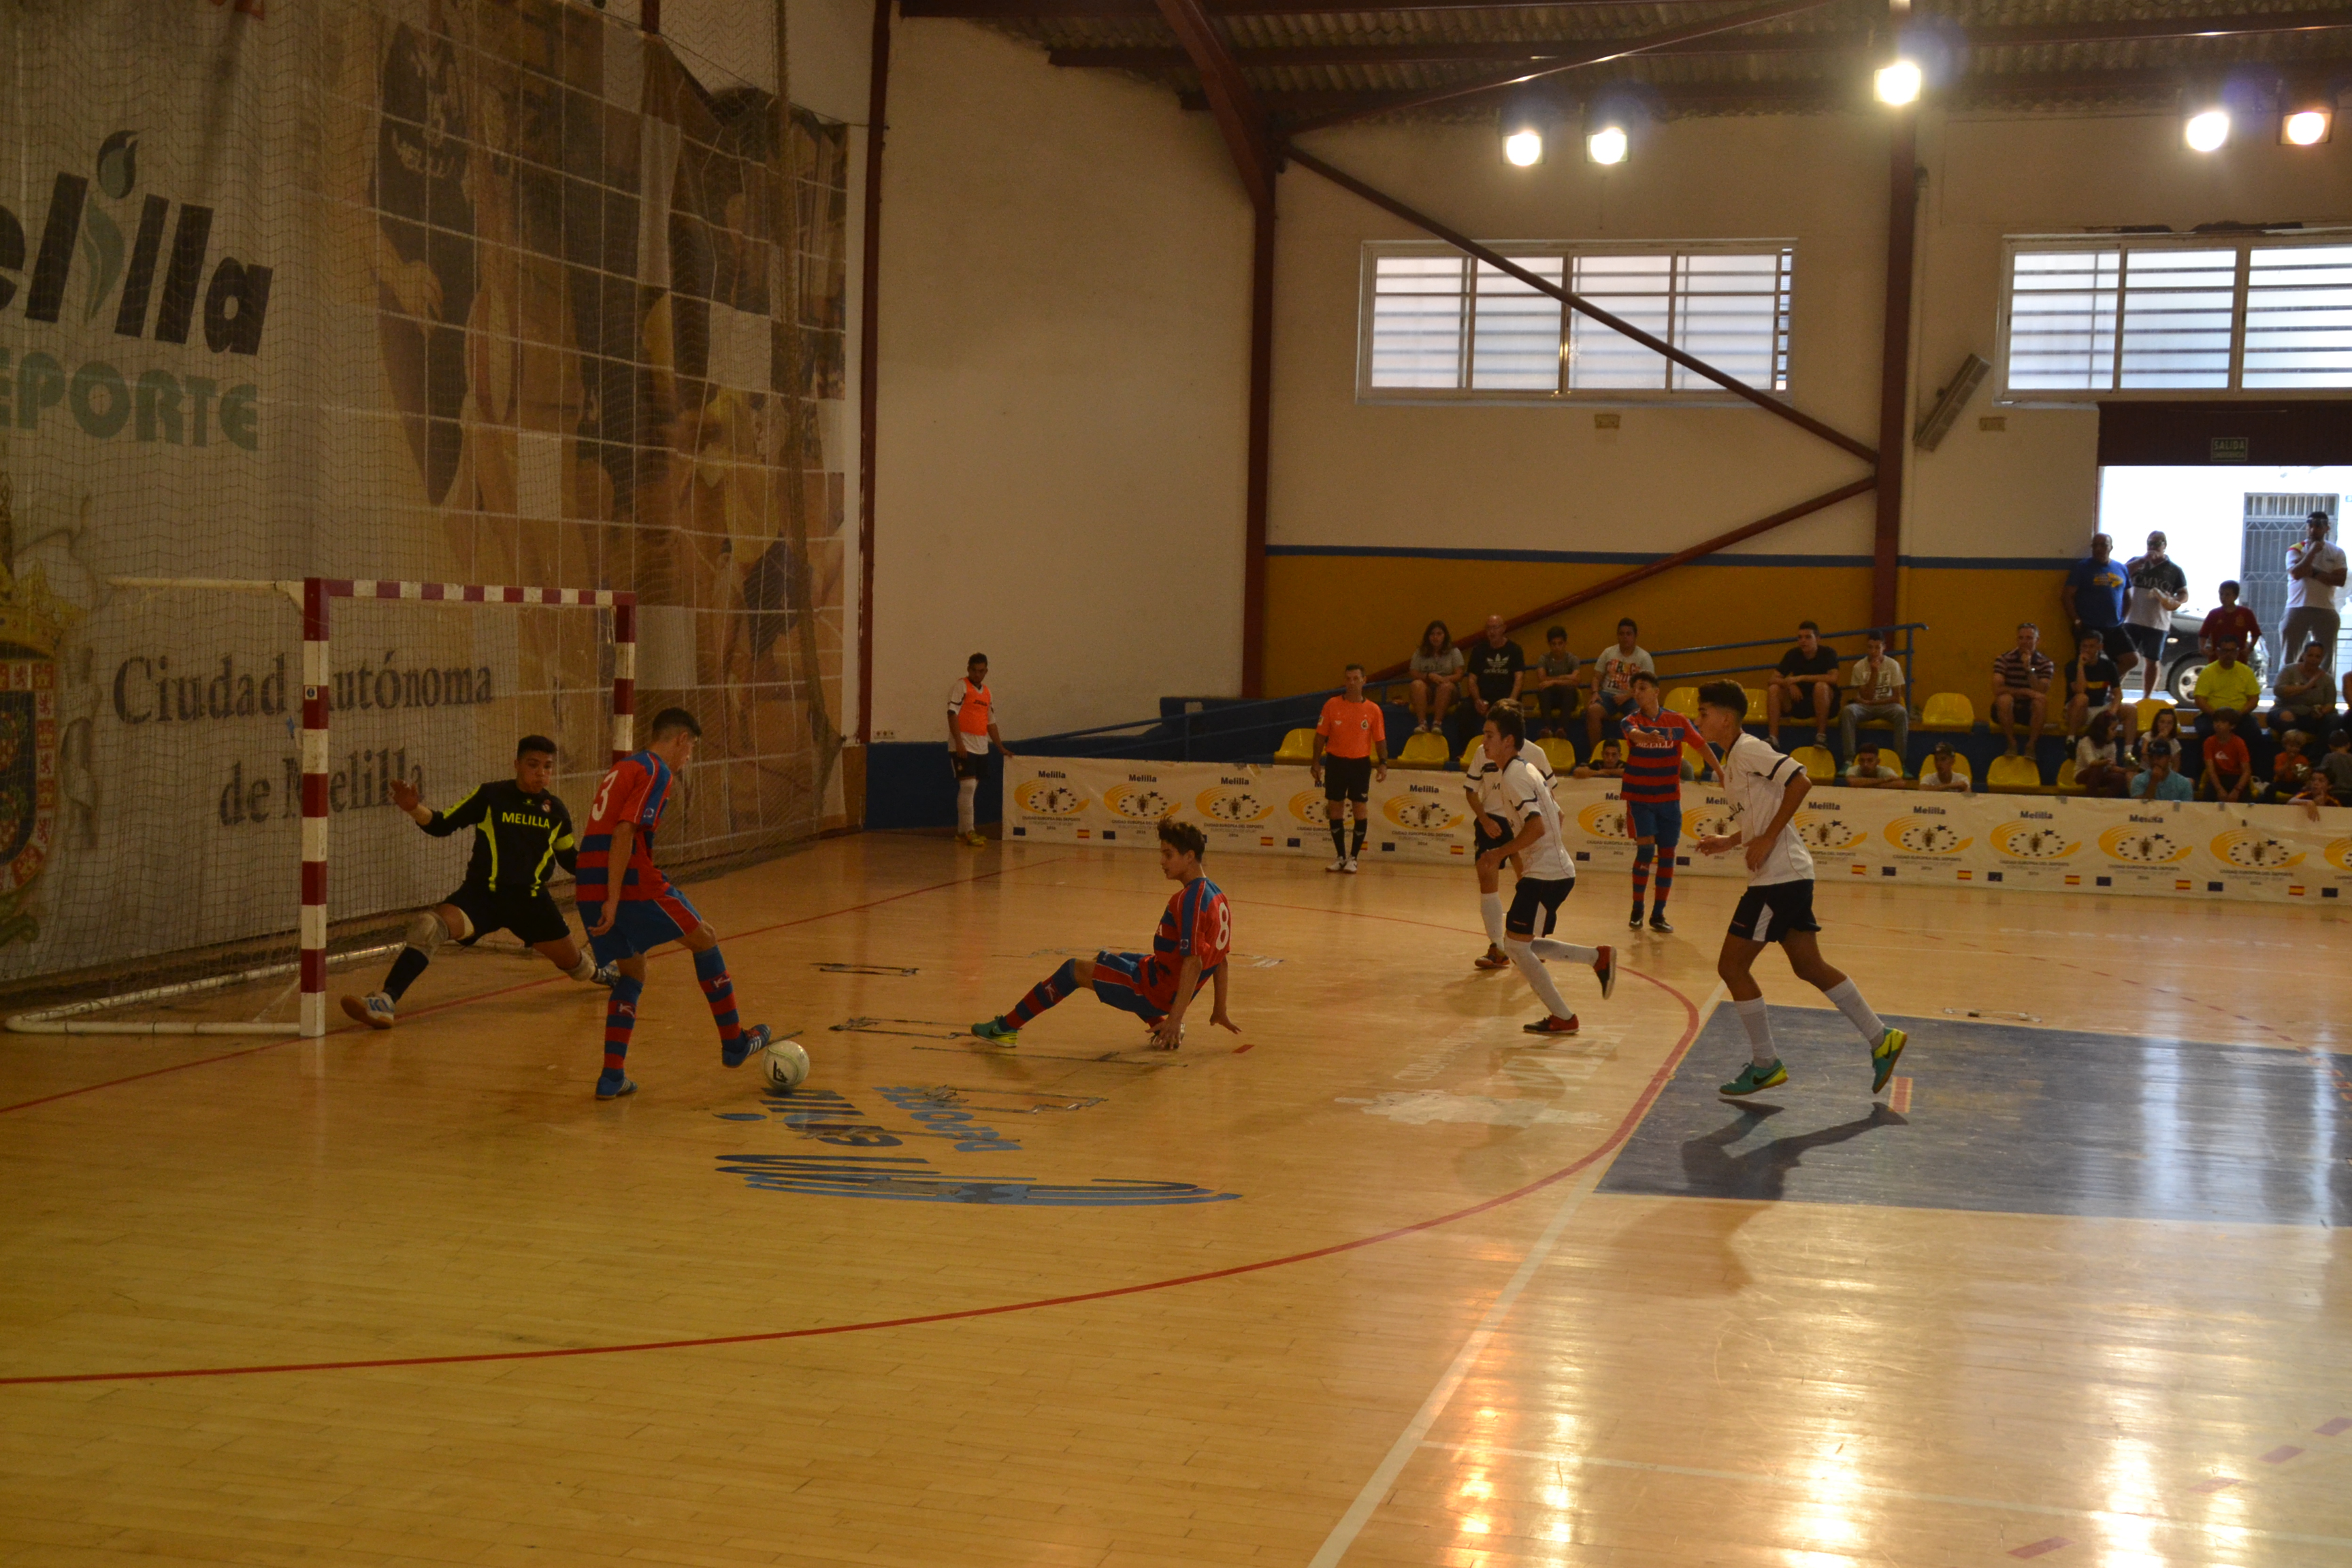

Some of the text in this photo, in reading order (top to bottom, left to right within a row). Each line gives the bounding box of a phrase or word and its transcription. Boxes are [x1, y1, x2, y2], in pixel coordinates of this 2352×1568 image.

[0, 346, 259, 451] PORTE
[114, 651, 493, 724] Ciudad utónoma
[1039, 770, 1066, 779] Melilla
[1129, 774, 1157, 782] Melilla
[1221, 777, 1250, 785] Melilla
[220, 760, 270, 826] de
[591, 770, 619, 821] 3
[1409, 784, 1439, 793] Melilla
[1808, 802, 1840, 811] Melilla
[1913, 806, 1946, 815] Melilla
[502, 811, 550, 830] MELILLA
[1215, 902, 1229, 951] 8
